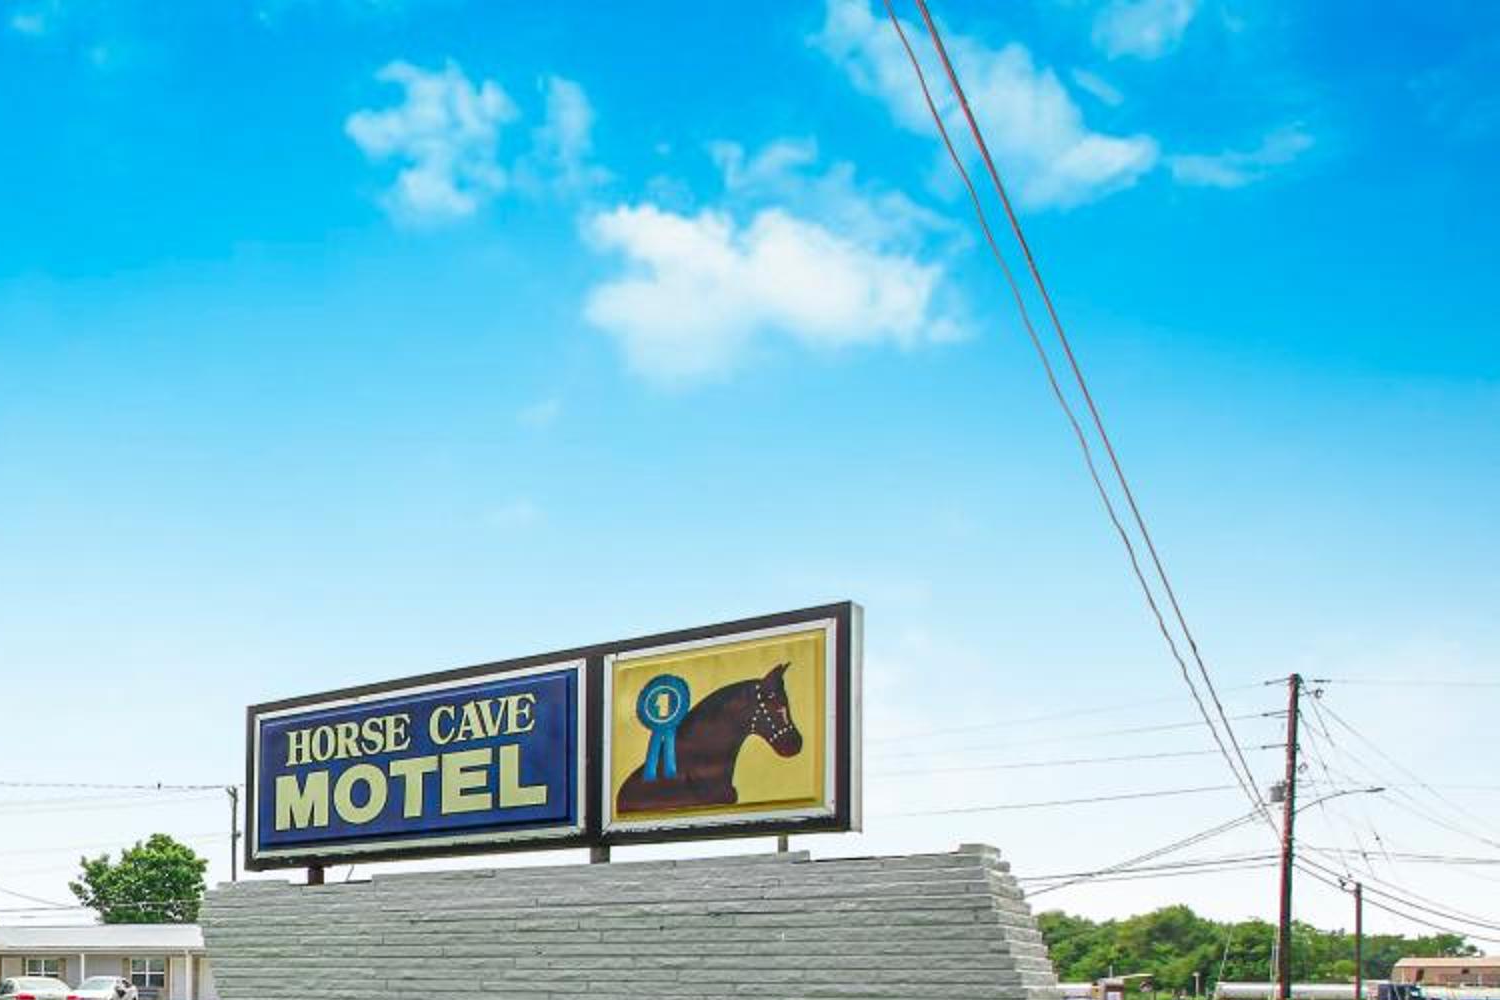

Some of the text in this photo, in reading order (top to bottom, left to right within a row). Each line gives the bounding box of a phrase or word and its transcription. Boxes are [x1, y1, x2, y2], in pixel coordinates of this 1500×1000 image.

[285, 693, 536, 767] HORSE CAVE
[655, 693, 670, 717] 1
[275, 743, 548, 831] MOTEL
